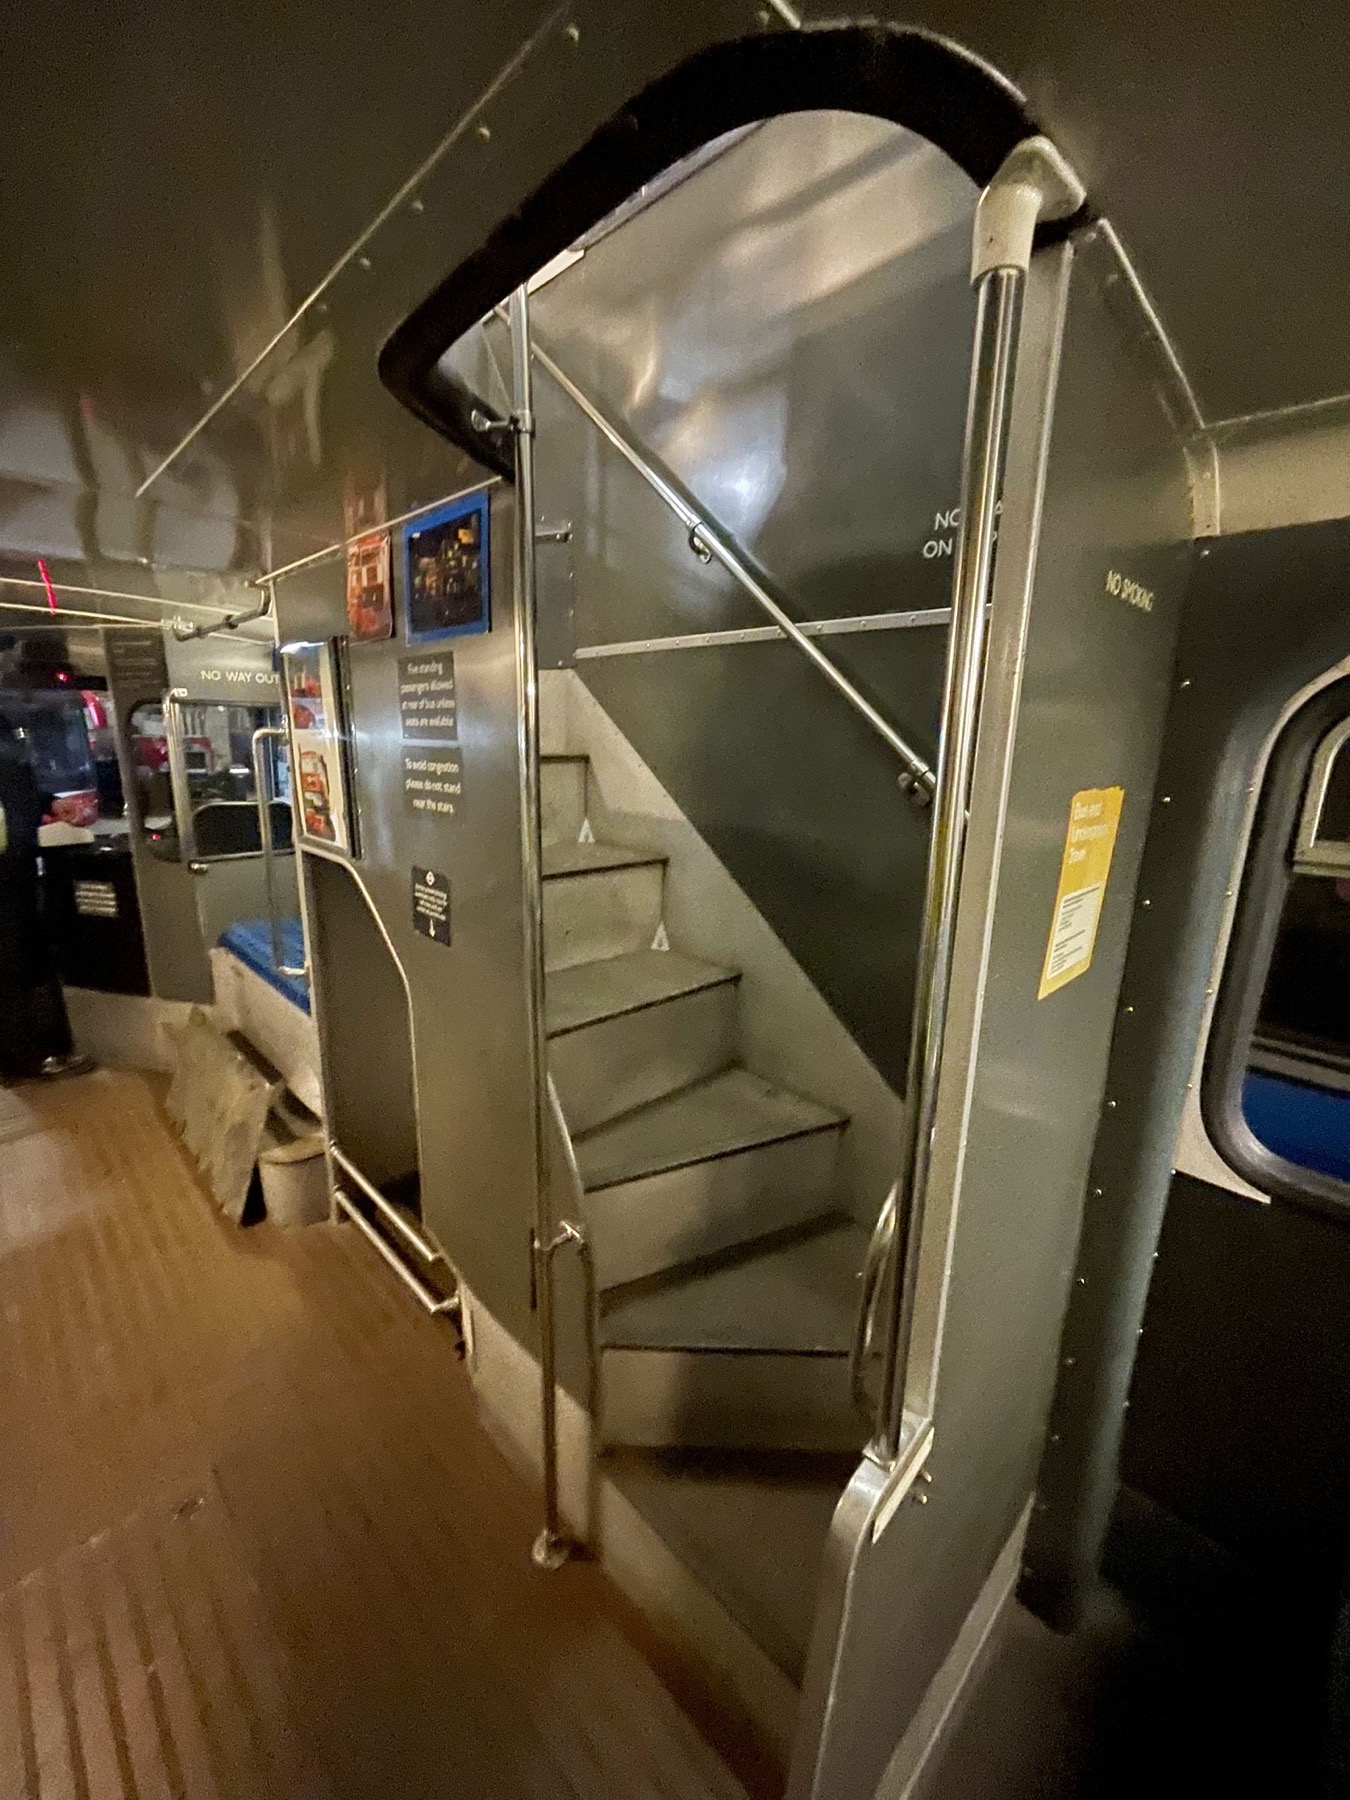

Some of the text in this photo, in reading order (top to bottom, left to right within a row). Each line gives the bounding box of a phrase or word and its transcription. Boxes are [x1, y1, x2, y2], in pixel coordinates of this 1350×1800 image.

[923, 538, 953, 559] ON
[1105, 570, 1122, 596] NO
[200, 670, 280, 684] NO WAY OUT
[404, 758, 412, 770] To
[405, 778, 424, 791] please
